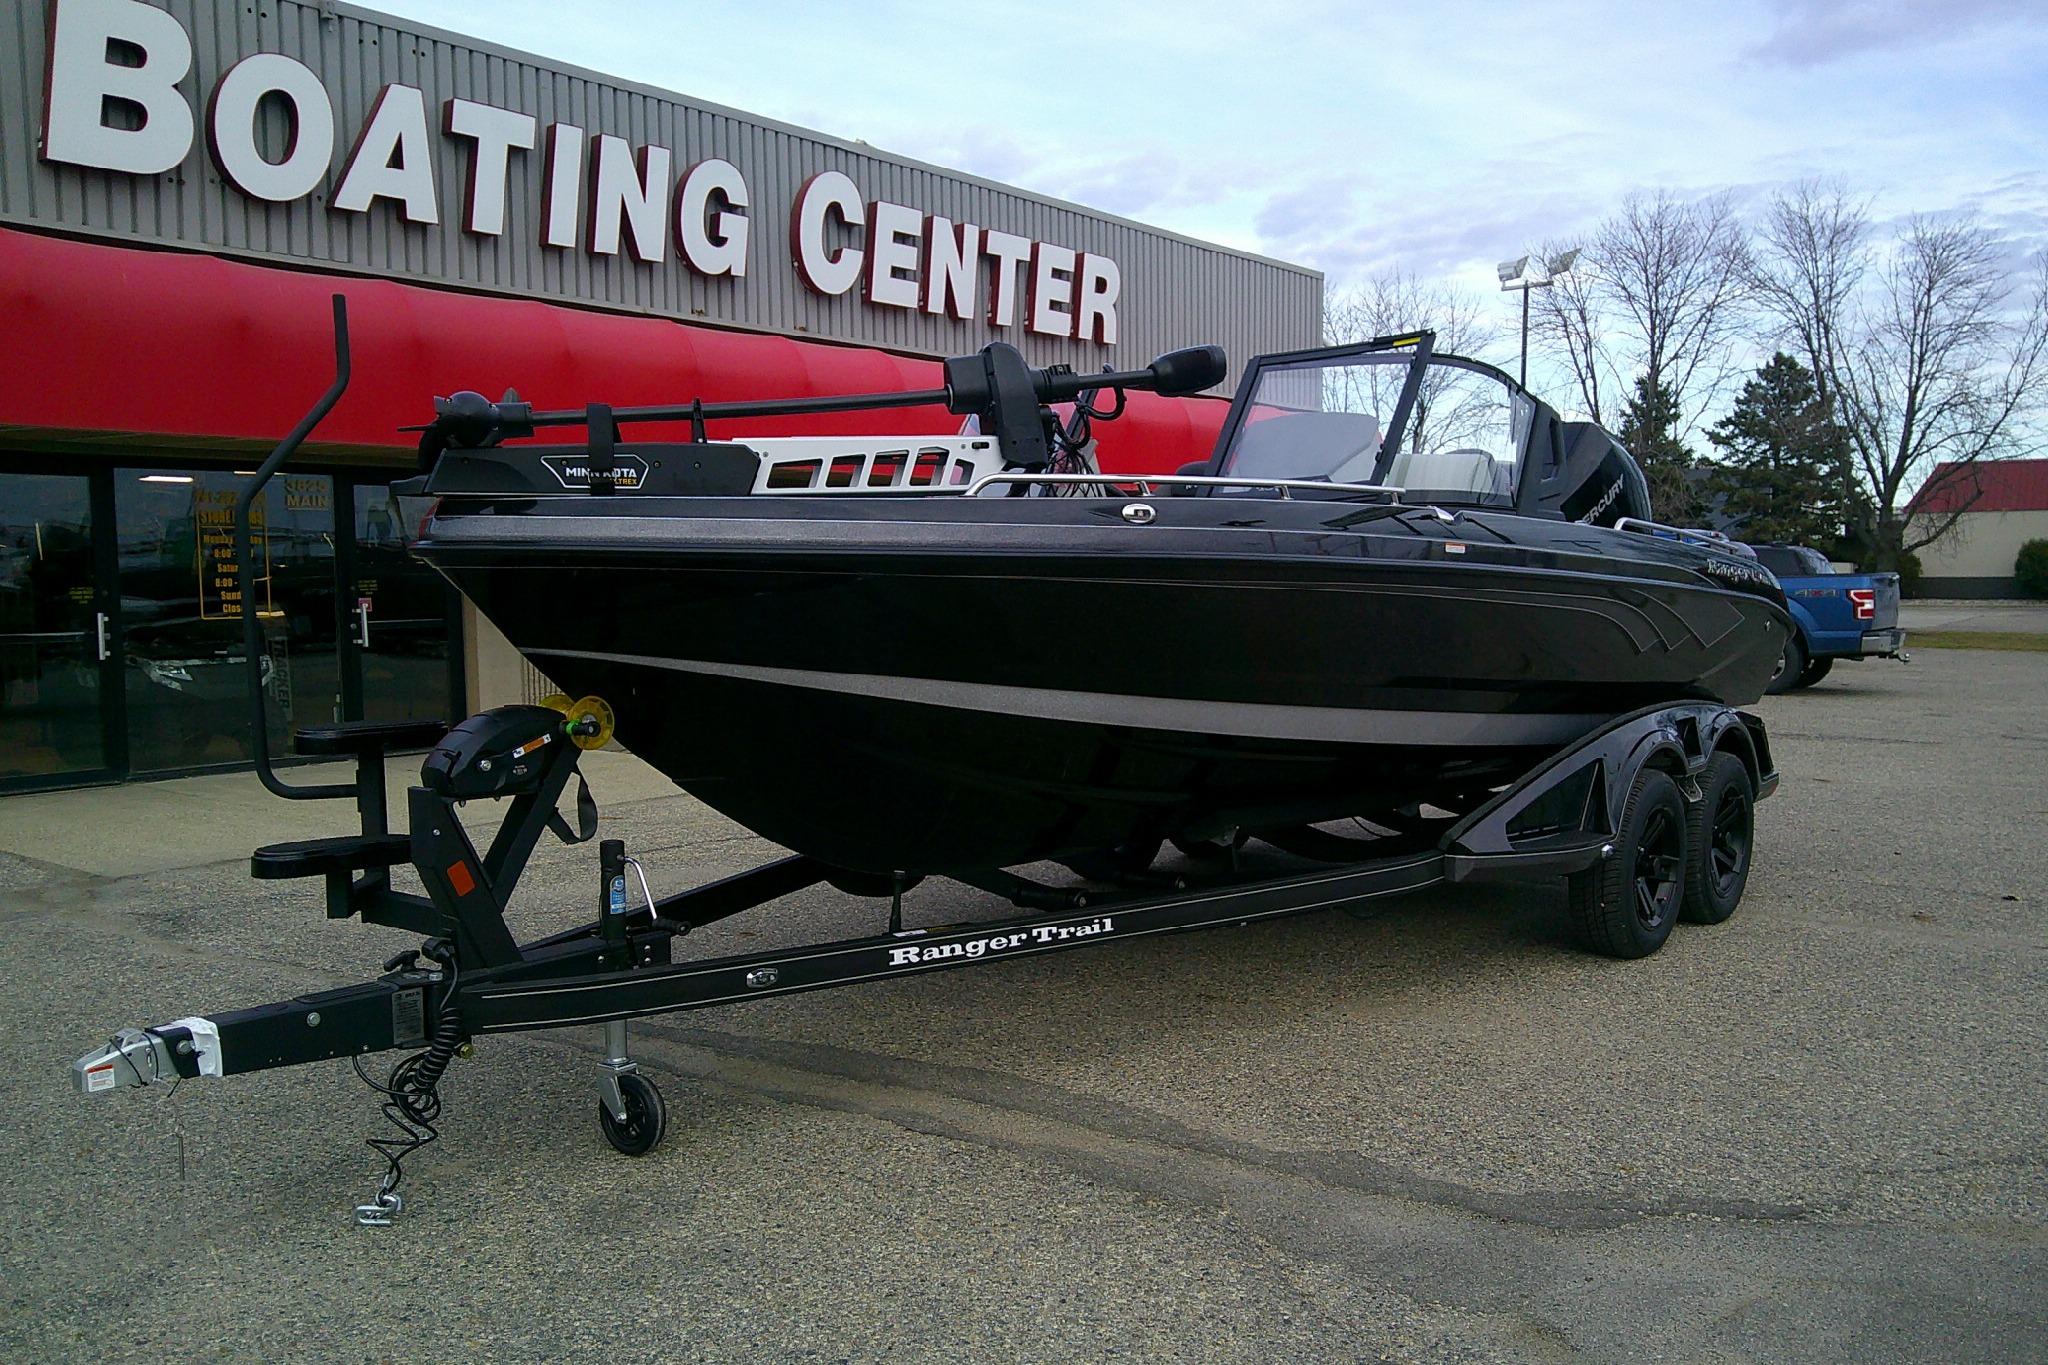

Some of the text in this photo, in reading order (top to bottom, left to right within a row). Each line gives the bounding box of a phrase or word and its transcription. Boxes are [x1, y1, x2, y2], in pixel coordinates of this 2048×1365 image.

[40, 0, 1121, 345] BOATING CENTER
[287, 495, 328, 507] MAIN
[1581, 473, 1624, 525] ERCURY
[889, 917, 1115, 966] Ranger Trail
